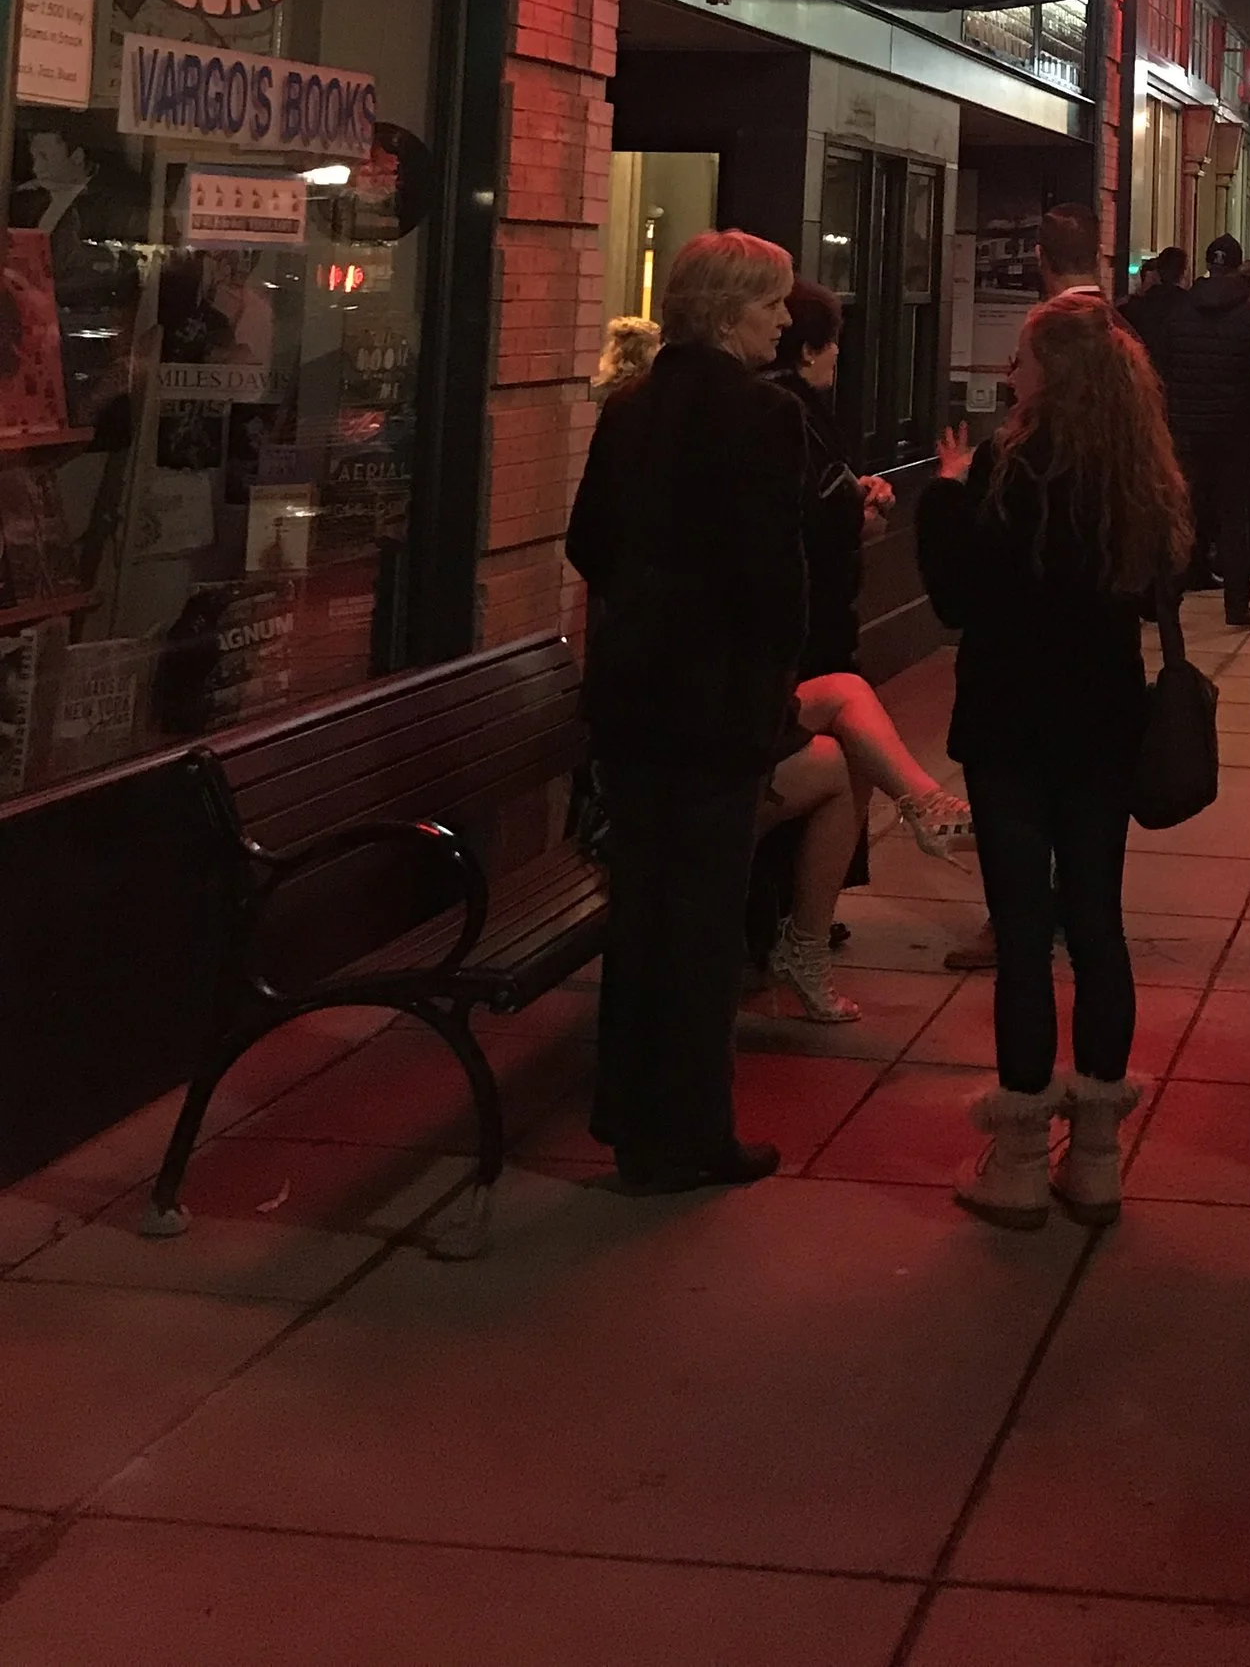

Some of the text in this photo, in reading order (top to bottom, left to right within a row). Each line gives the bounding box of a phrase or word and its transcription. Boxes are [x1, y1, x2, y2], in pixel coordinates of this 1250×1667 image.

[137, 45, 378, 151] VARGO'S BOOKS
[157, 369, 291, 390] MILES DAVIS
[216, 612, 294, 652] AGNUM
